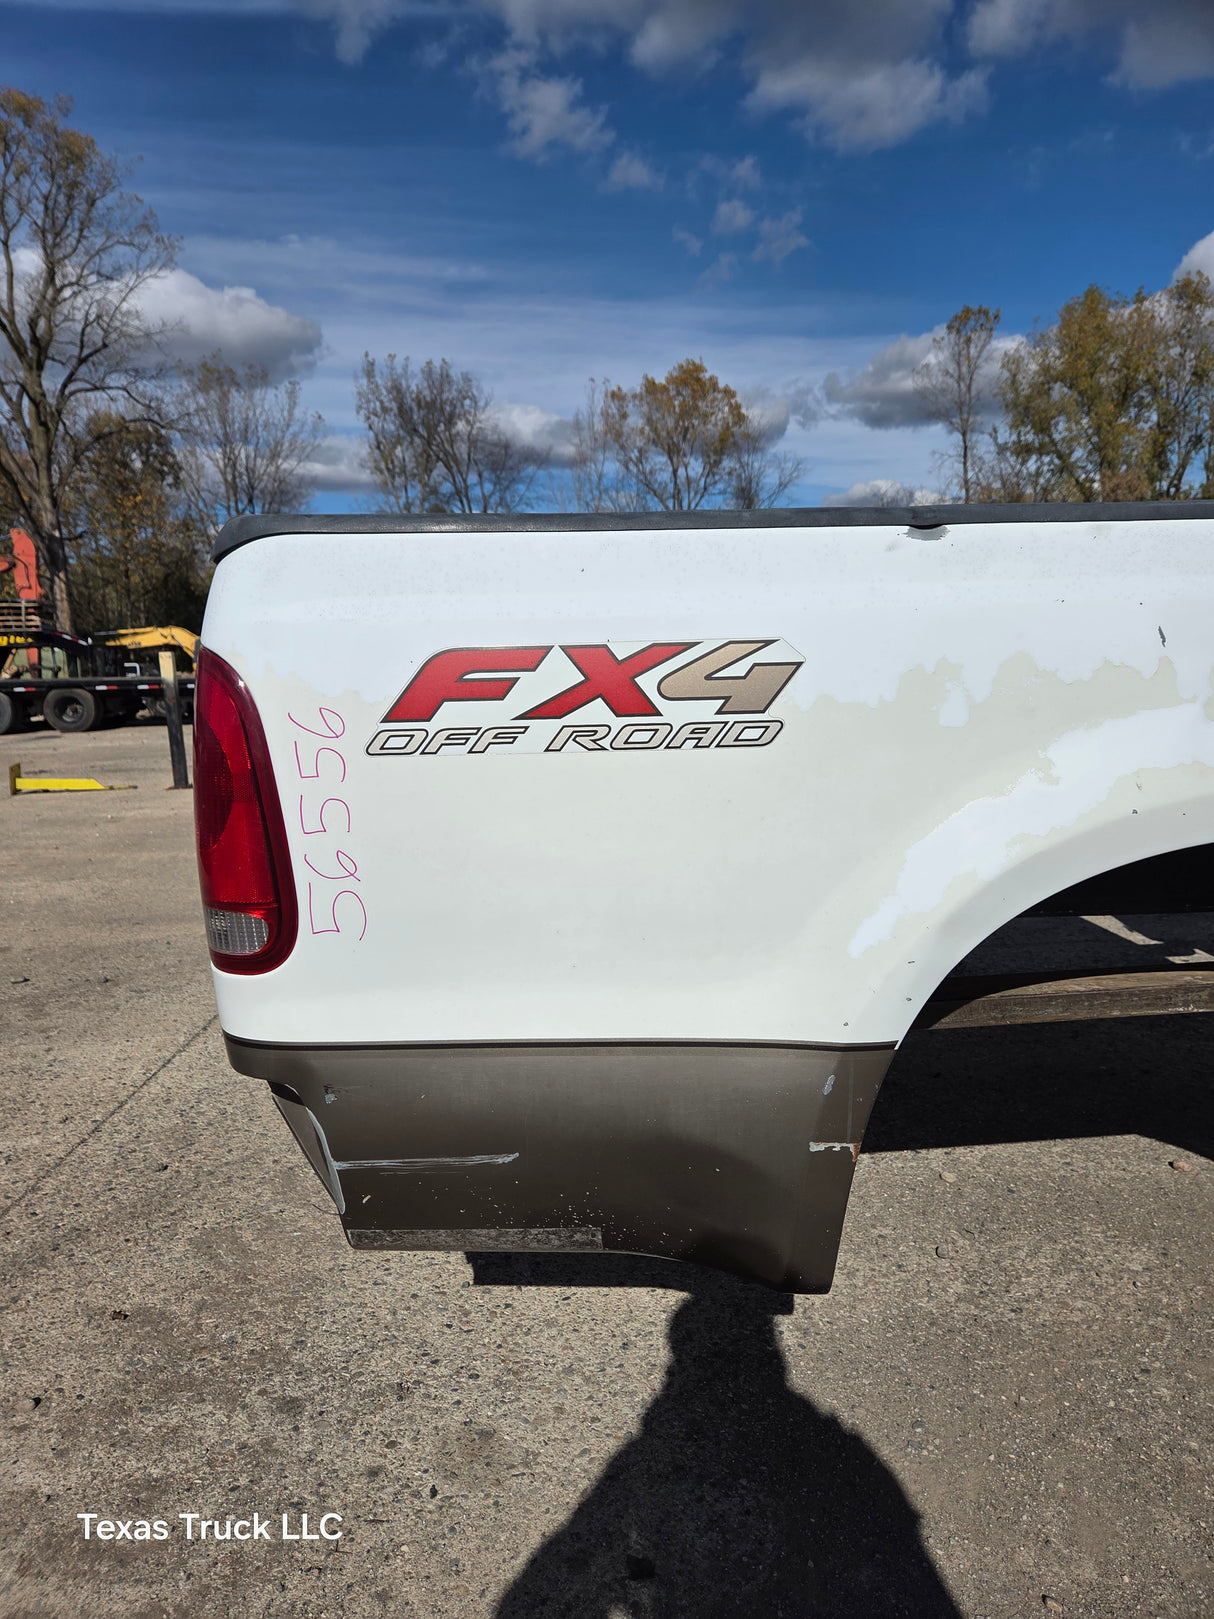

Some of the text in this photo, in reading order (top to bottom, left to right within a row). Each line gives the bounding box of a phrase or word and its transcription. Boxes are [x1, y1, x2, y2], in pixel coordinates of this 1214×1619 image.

[379, 639, 805, 723] FX4
[366, 720, 784, 756] OFF ROAD
[287, 706, 367, 941] 56556
